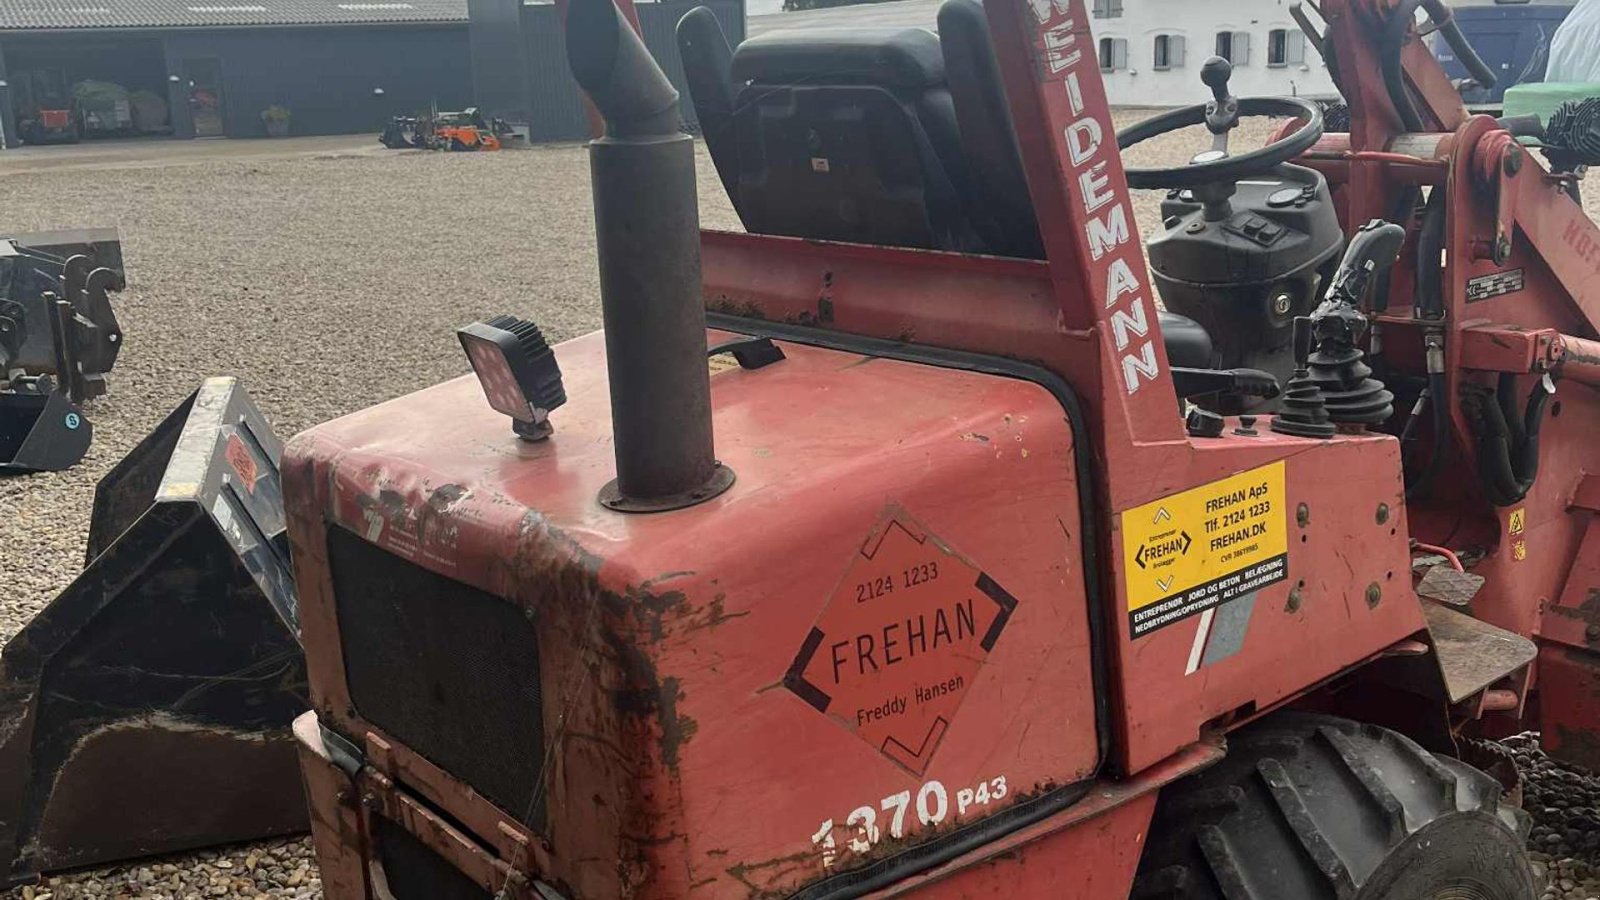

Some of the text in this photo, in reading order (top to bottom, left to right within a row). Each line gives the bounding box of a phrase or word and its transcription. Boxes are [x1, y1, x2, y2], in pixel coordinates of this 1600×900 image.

[1206, 482, 1268, 513] FREHAN ApS
[1205, 501, 1270, 533] Tlf. 2124 1233
[1144, 537, 1183, 562] FREHAN
[1210, 521, 1266, 552] FREHAN.DK
[856, 562, 938, 603] 2124 1233
[1134, 558, 1283, 622] ENTREPRENØR JORD OG BETON BELÆGNING
[1223, 588, 1234, 599] ALT
[1238, 569, 1283, 592] GRAVEARBEJDE
[831, 598, 976, 684] FREHAN
[857, 675, 964, 727] Freddy Hansen
[811, 775, 1008, 868] 1370 P43
